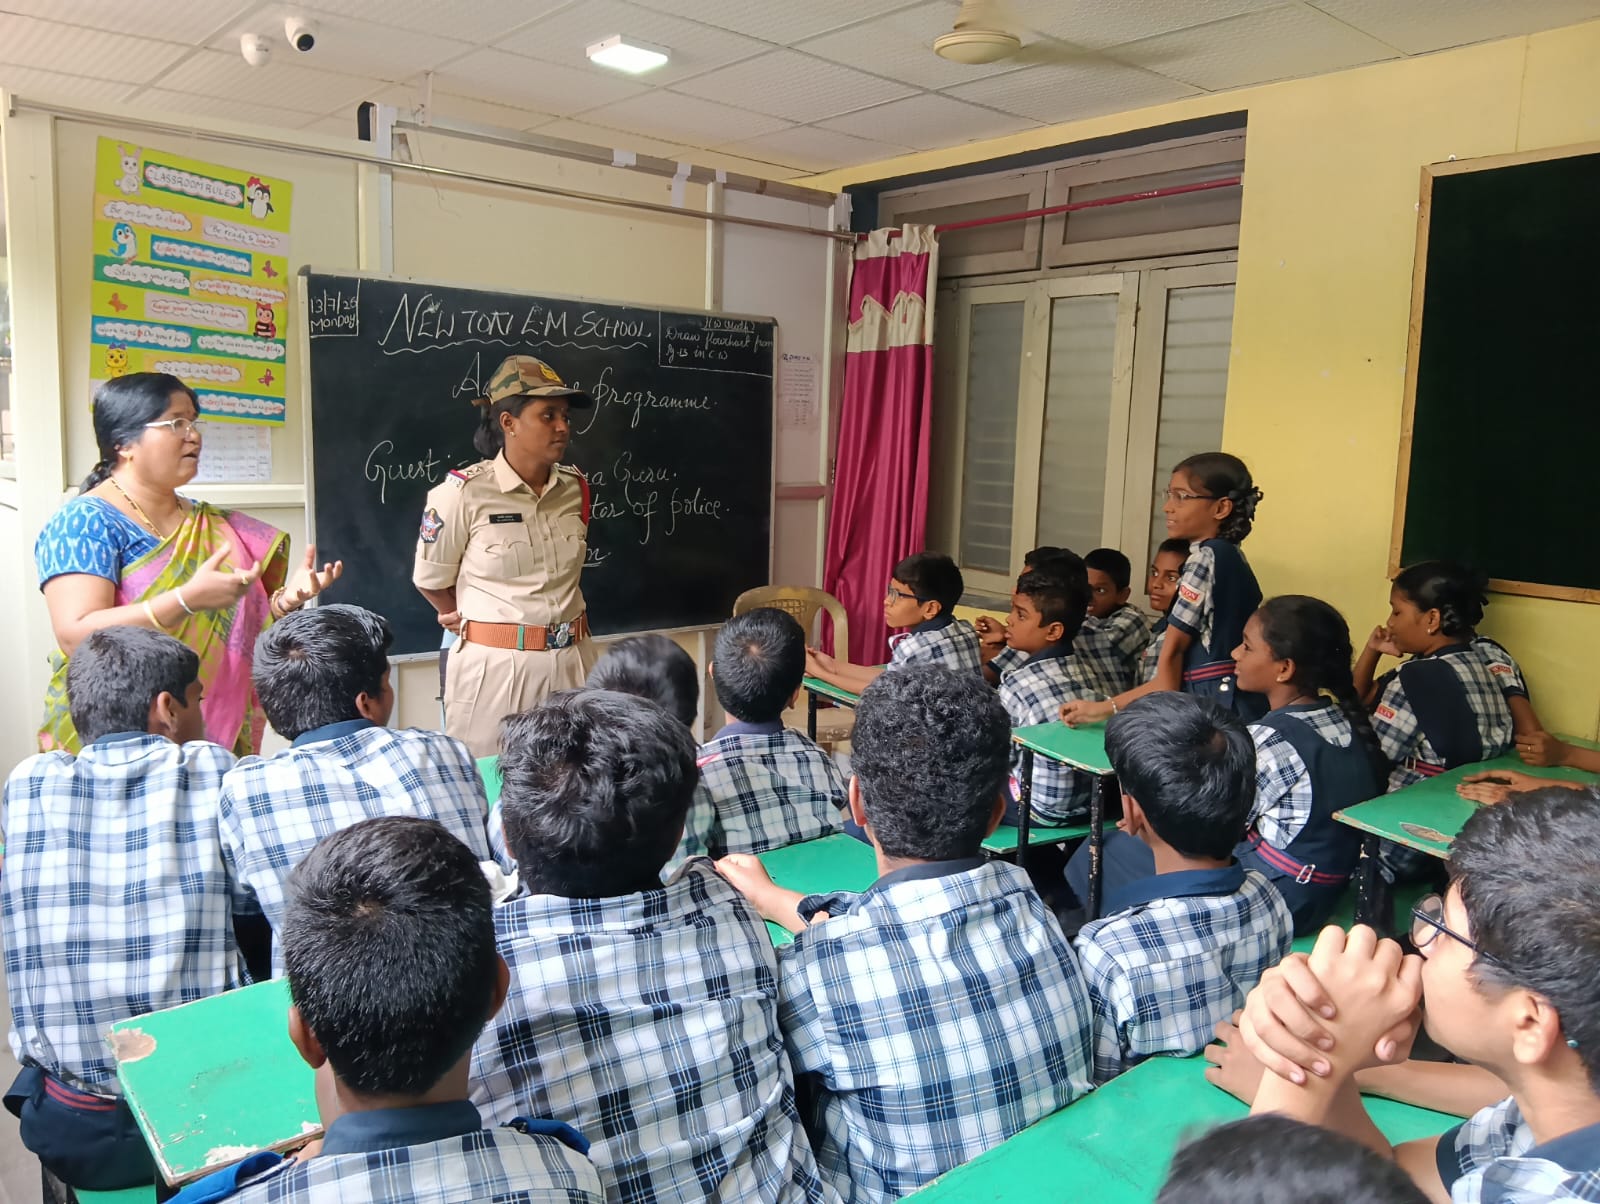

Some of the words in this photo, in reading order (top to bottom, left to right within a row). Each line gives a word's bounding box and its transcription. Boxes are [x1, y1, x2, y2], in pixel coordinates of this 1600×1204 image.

[150, 168, 204, 190] CLASSROOM
[206, 184, 237, 200] RULES
[574, 310, 652, 338] SCHOOL
[665, 327, 701, 342] Draw
[365, 439, 441, 504] Guest
[632, 491, 658, 544] of
